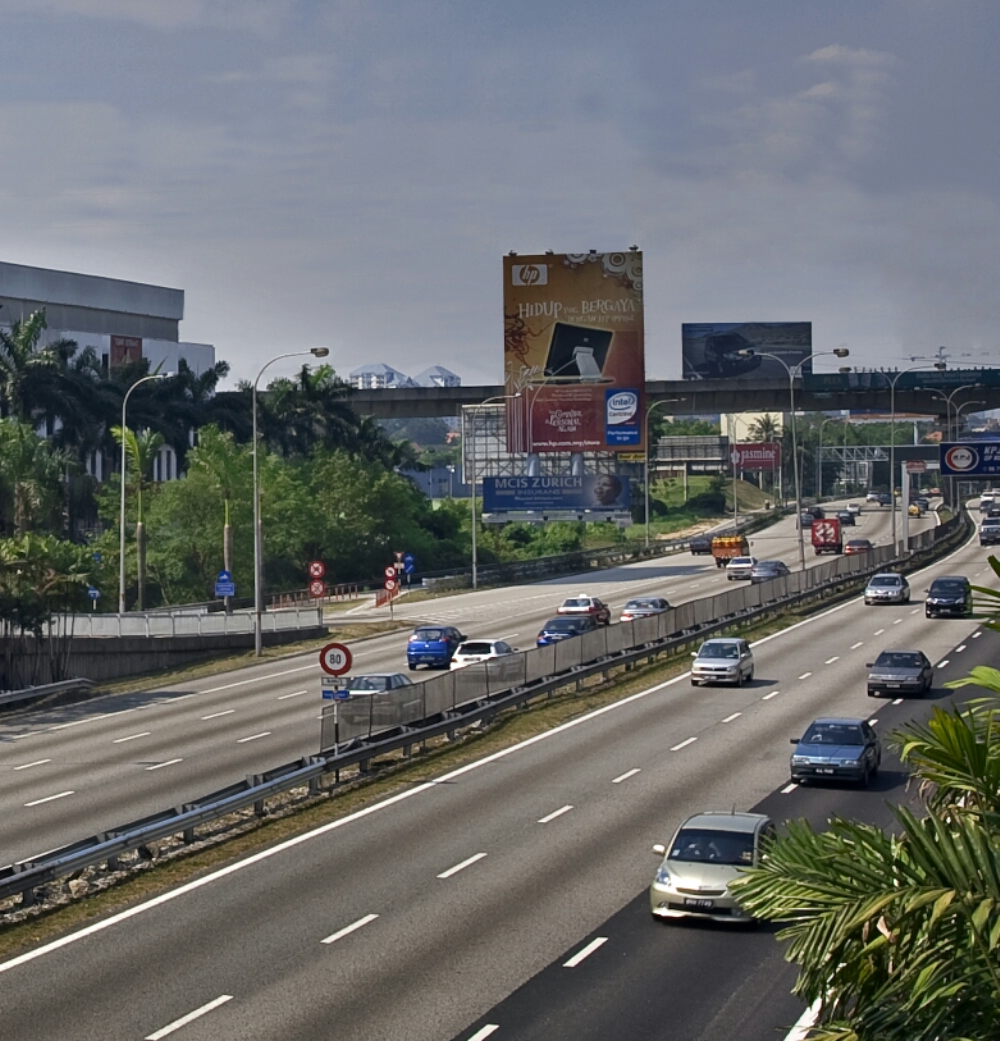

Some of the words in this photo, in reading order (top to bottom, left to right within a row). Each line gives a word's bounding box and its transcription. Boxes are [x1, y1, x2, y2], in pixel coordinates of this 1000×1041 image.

[581, 298, 635, 315] BERGAYA
[740, 447, 776, 465] jasmine
[494, 478, 529, 489] MCIS
[531, 477, 582, 488] ZURICH
[330, 654, 342, 665] 80
